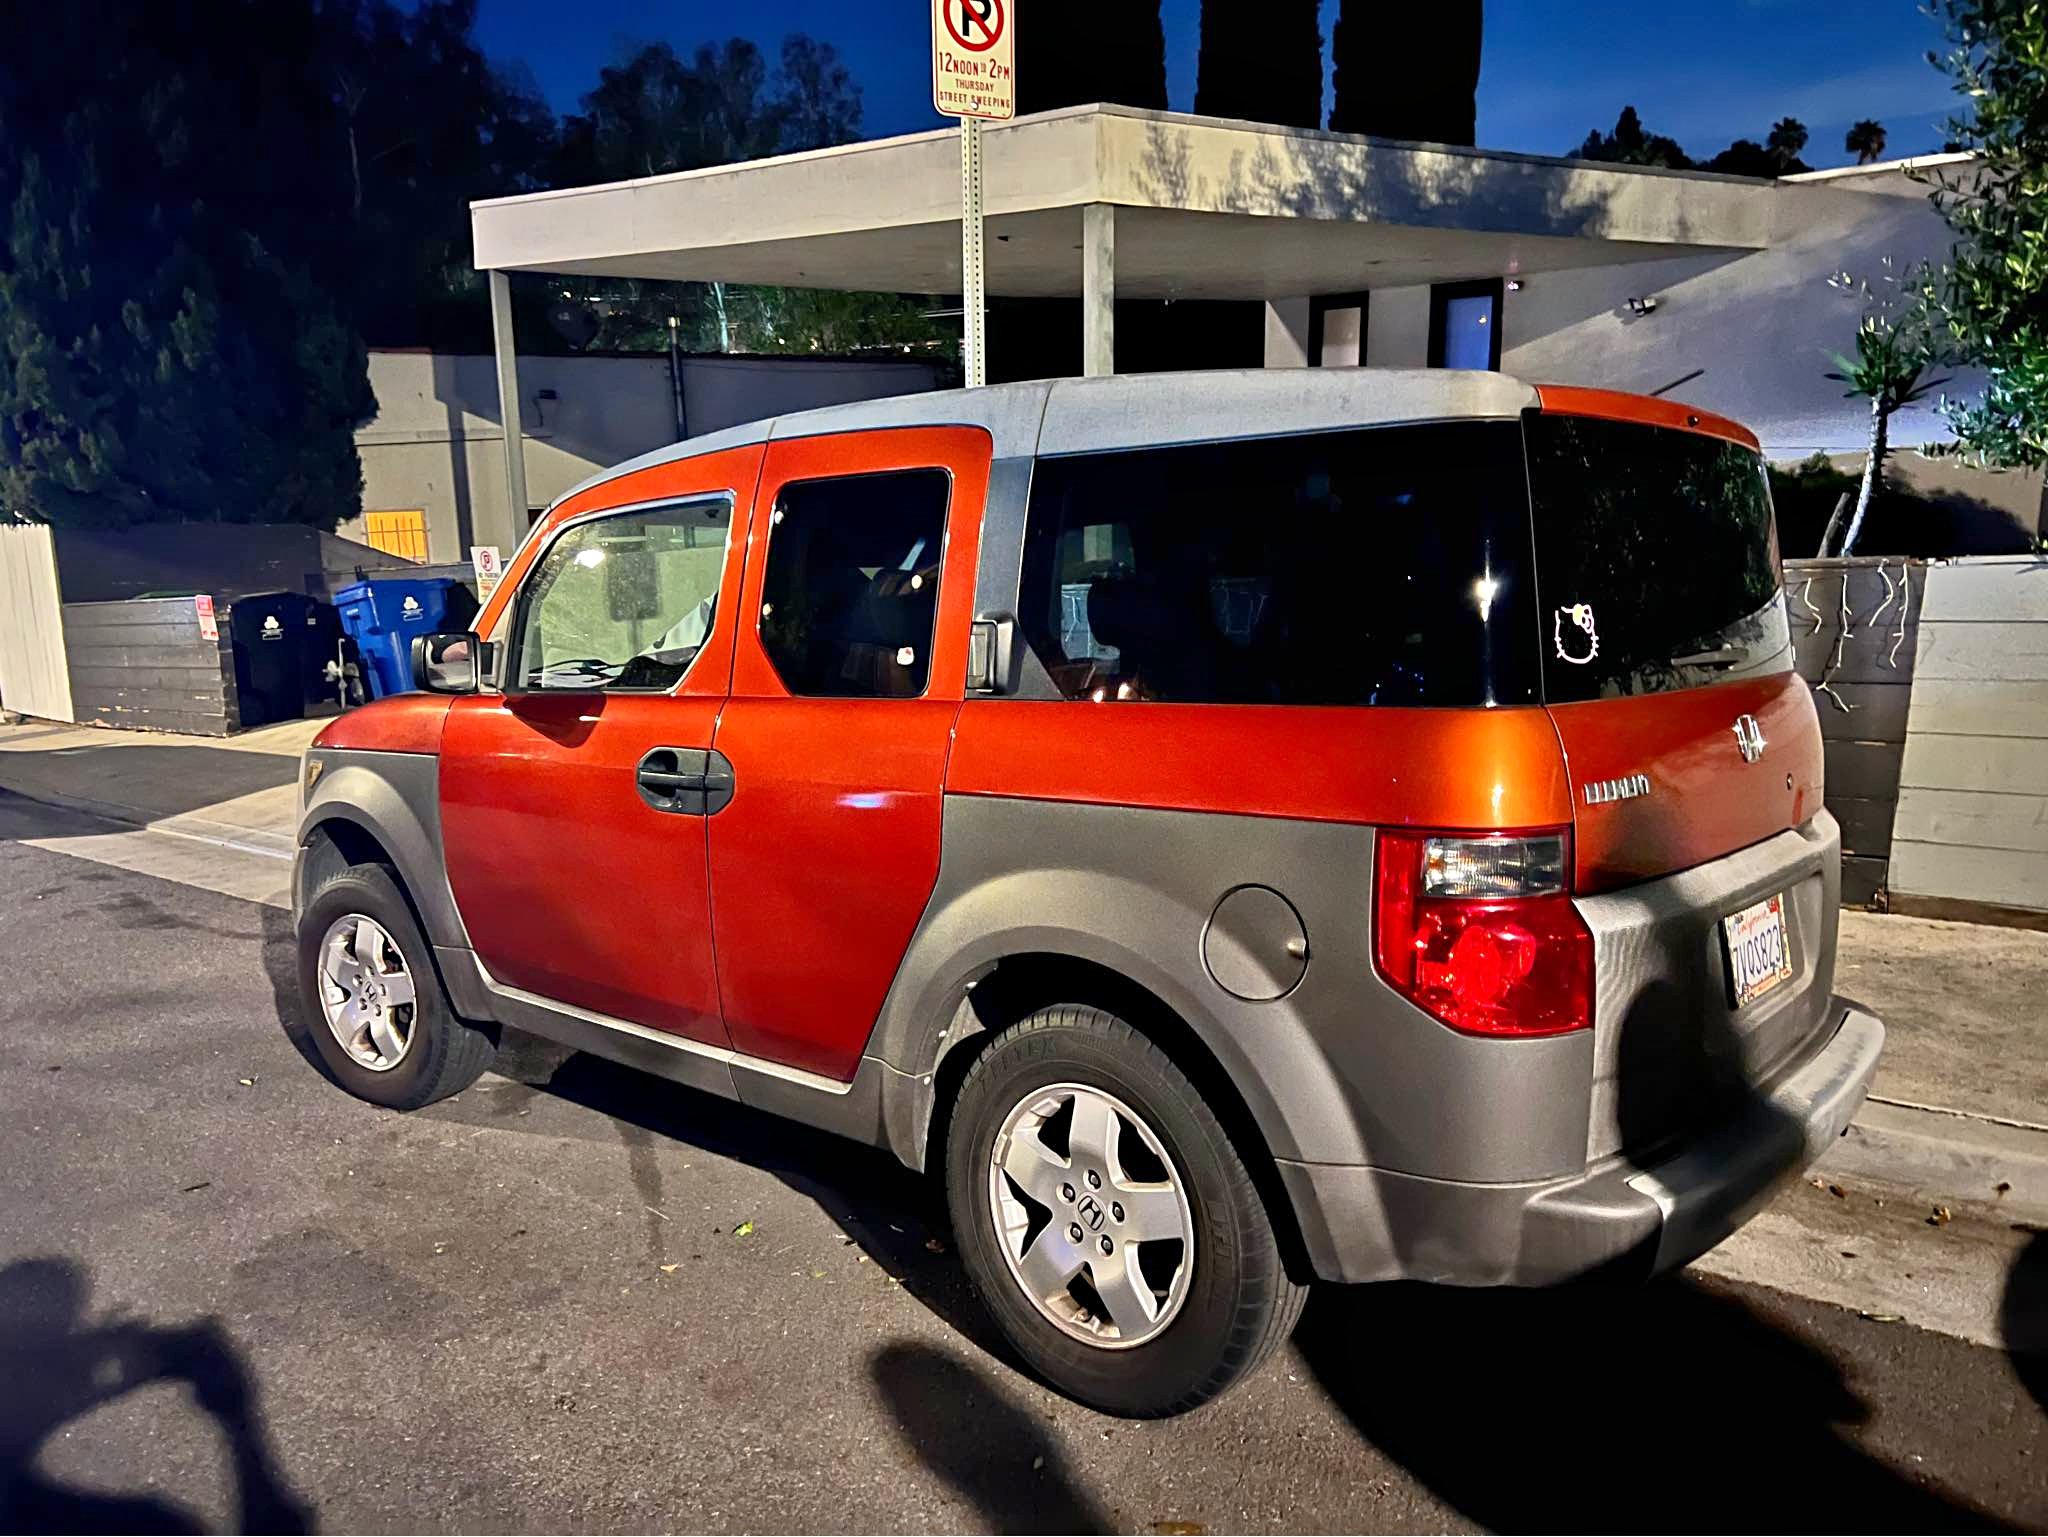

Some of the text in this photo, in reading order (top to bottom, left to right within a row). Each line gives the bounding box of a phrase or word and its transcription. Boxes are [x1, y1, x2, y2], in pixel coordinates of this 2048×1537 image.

[989, 58, 1010, 80] 2PM
[955, 78, 995, 93] THURSDAY
[939, 91, 1010, 109] STREET SWEEPING
[1733, 924, 1782, 988] 7VQS823
